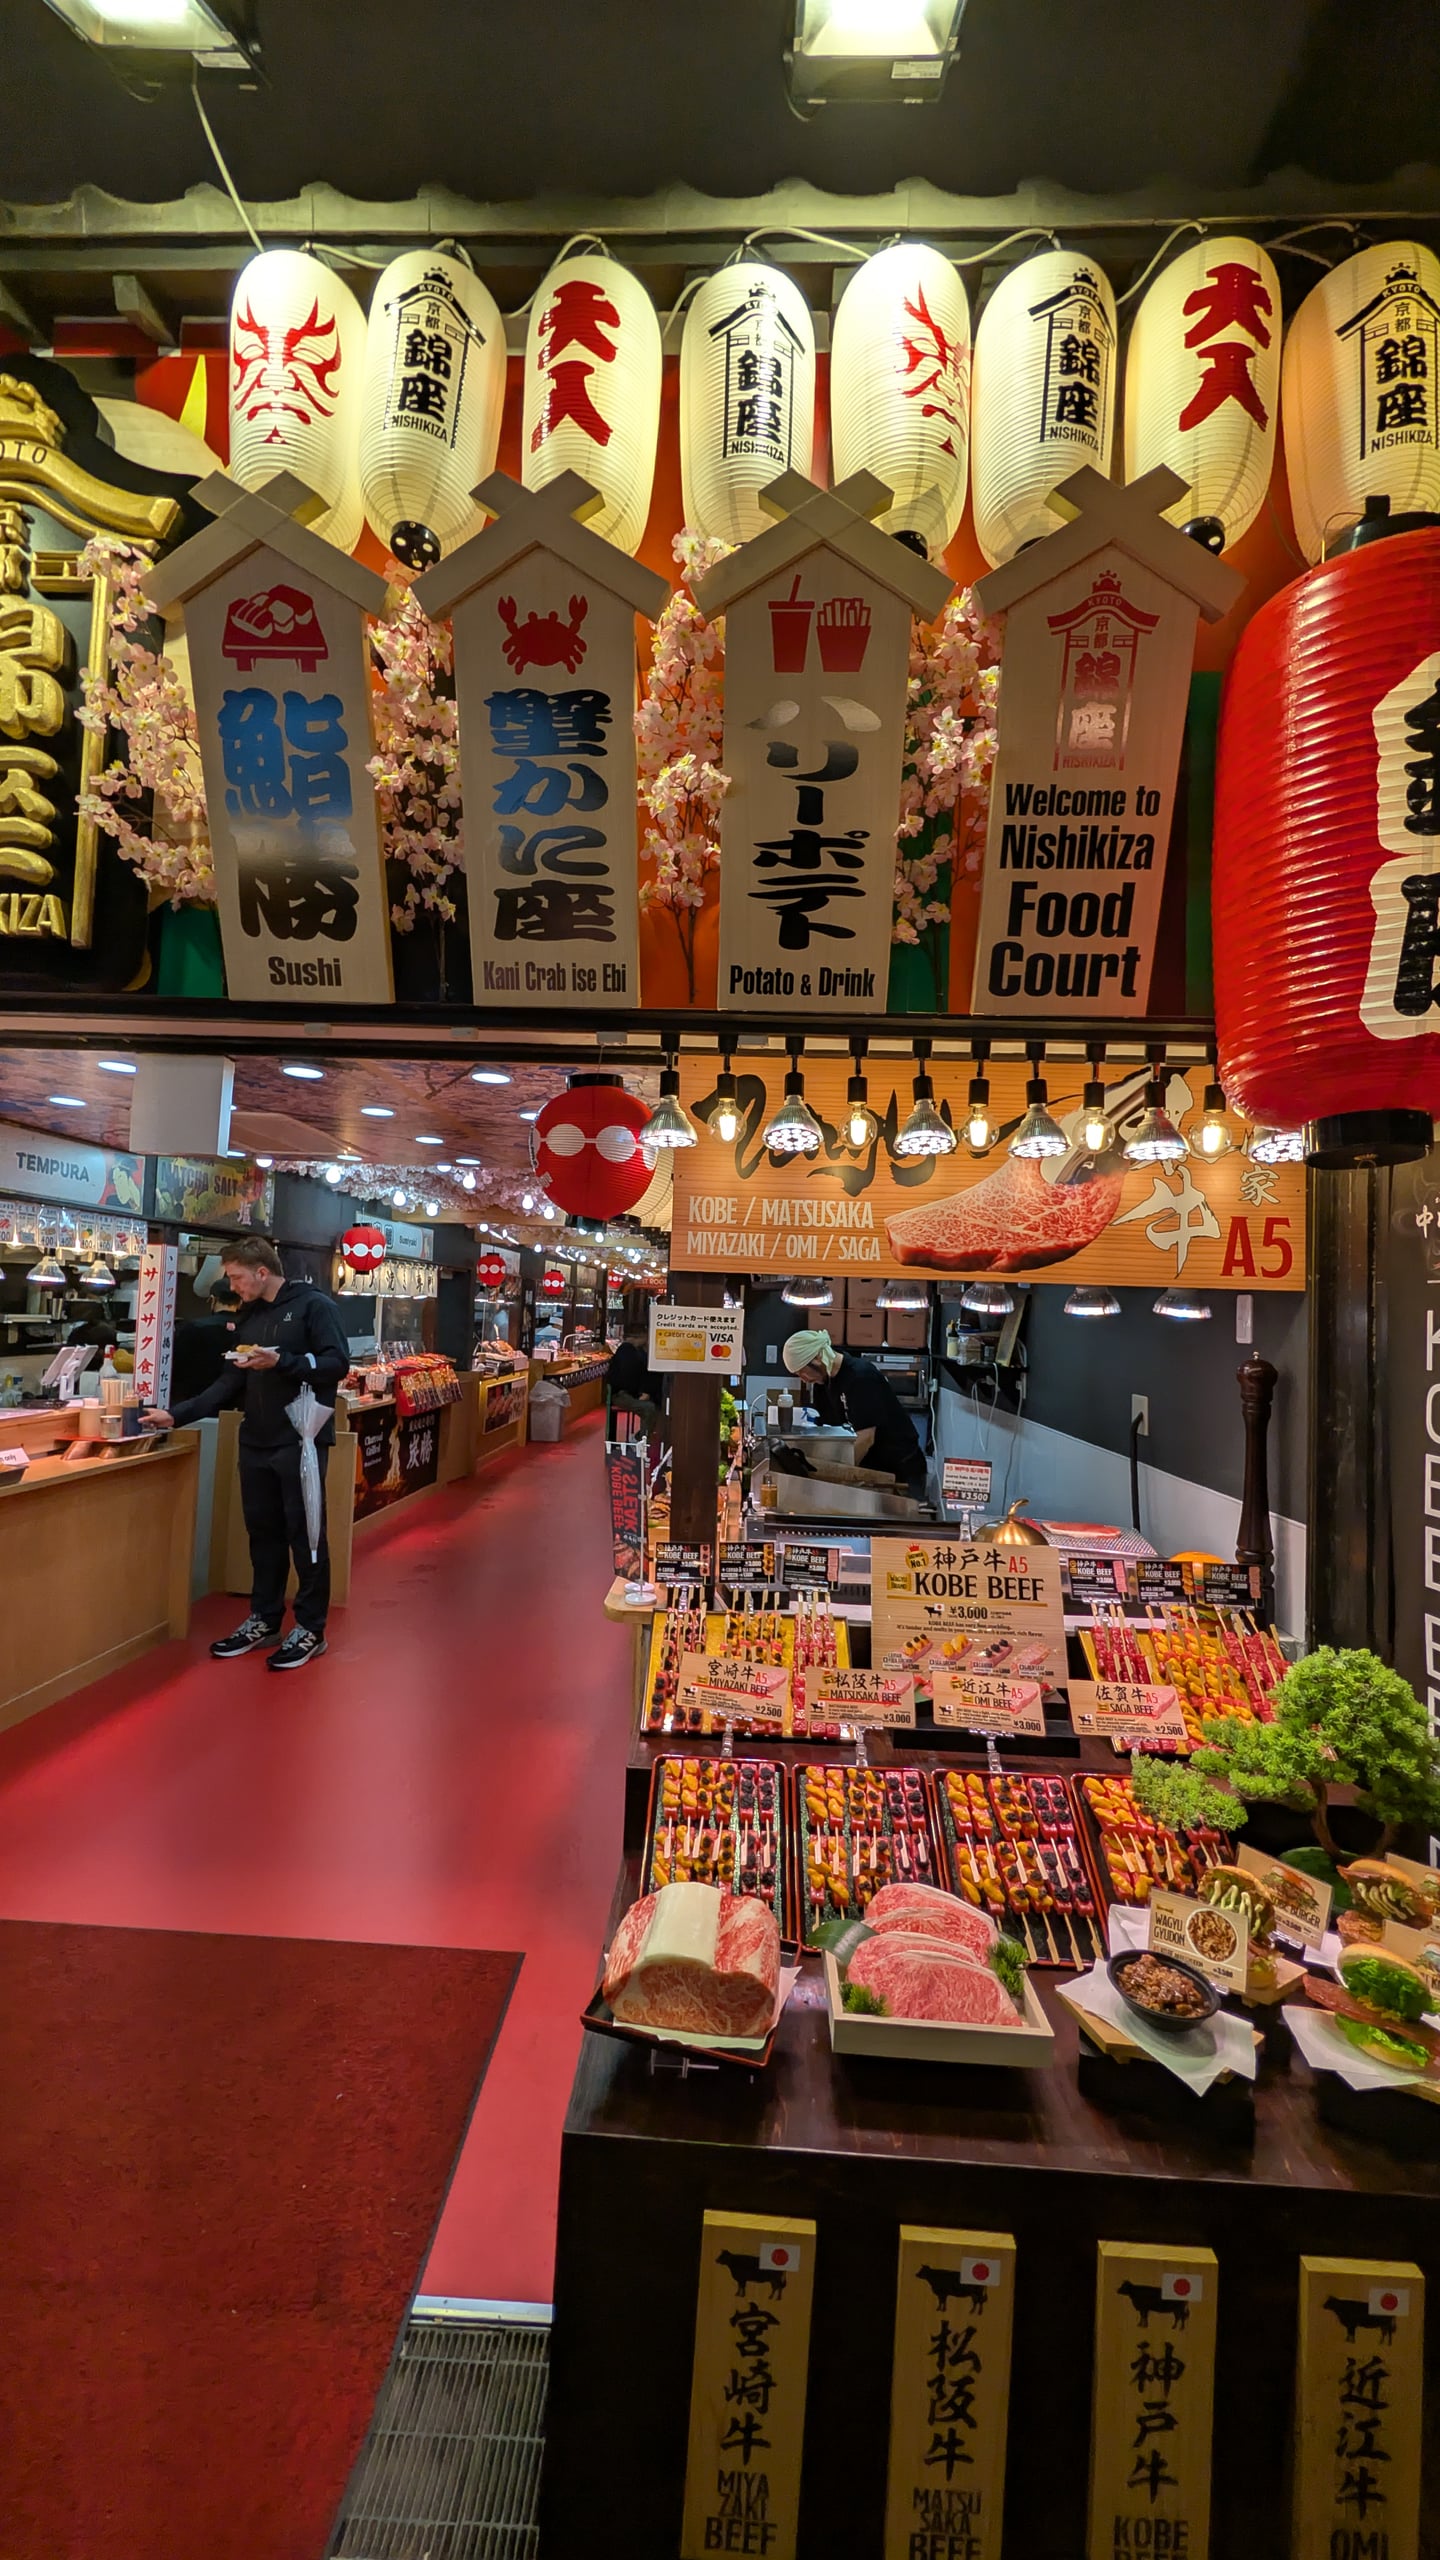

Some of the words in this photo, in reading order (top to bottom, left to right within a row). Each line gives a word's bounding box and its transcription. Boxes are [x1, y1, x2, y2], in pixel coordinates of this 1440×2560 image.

[419, 283, 454, 302] KYOTO
[1382, 283, 1420, 298] KYOTO
[425, 302, 443, 330] 京都
[1078, 304, 1091, 334] 京都
[1394, 302, 1411, 332] 京都
[398, 329, 452, 423] 錦座
[1055, 334, 1100, 432] 錦座
[1375, 334, 1428, 433] 錦座
[391, 415, 448, 443] NISHIKIZA
[1371, 430, 1434, 453] NISHIKIZA
[1087, 596, 1122, 606] KYOTO
[1093, 616, 1111, 649] 京都
[1067, 651, 1121, 750] 錦座
[1004, 783, 1127, 818] Welcome
[1134, 785, 1161, 817] to
[489, 688, 618, 943] 蟹かに座
[998, 824, 1156, 871] Nishikiza
[1007, 881, 1132, 938] Food
[268, 956, 342, 988] Sushi
[484, 961, 520, 991] Kani
[525, 961, 566, 992] Crab
[572, 962, 597, 992] ise
[602, 963, 627, 992] Ebi
[730, 964, 794, 998] Potato
[800, 975, 812, 997] &
[818, 966, 875, 998] Drink
[988, 941, 1141, 998] Court
[16, 1152, 89, 1183] TEMPURA
[213, 1177, 239, 1197] SALT
[688, 1195, 737, 1225] KOBE
[744, 1196, 756, 1226] /
[762, 1199, 875, 1229] MATSUSAKA
[687, 1231, 765, 1257] MIYAZAKI
[769, 1232, 782, 1259] /
[786, 1234, 818, 1260] OMI
[822, 1234, 834, 1261] /
[838, 1236, 881, 1261] SAGA
[1220, 1216, 1293, 1279] A5
[656, 1313, 737, 1324] クレジットカード使えます
[160, 1270, 175, 1409] アツアツ揚げたて
[663, 1331, 686, 1339] CREDIT
[709, 1333, 734, 1343] VISA
[683, 1552, 699, 1560] BEEF
[727, 1551, 745, 1559] KOBE
[746, 1551, 762, 1559] BEEF
[792, 1554, 809, 1562] KOBE
[910, 1559, 926, 1568] No.1
[932, 1546, 1007, 1573] 神戸牛
[1008, 1556, 1029, 1574] A5
[914, 1572, 978, 1598] KOBE
[987, 1575, 1044, 1601] BEEF
[1145, 1570, 1162, 1578] KOBE
[708, 1659, 756, 1681] 宮崎牛
[755, 1671, 768, 1684] A5
[834, 1671, 885, 1690] 松阪牛
[884, 1679, 896, 1691] A5
[709, 1677, 748, 1692] MIYAZAKI
[750, 1683, 770, 1695] BEEF
[830, 1689, 879, 1702] MATSUSAKA
[881, 1692, 902, 1703] BEEF
[962, 1678, 1011, 1697] 近江牛
[1011, 1687, 1024, 1699] A5
[1096, 1684, 1146, 1703] 佐賀牛
[1145, 1692, 1159, 1704] A5
[974, 1696, 991, 1706] OMI
[993, 1698, 1013, 1709] BEEF
[1109, 1703, 1132, 1713] SAGA
[1134, 1705, 1154, 1715] BEEF
[1155, 1912, 1183, 1931] WAGYU
[1291, 1905, 1321, 1928] BURGER
[1153, 1926, 1185, 1946] GYUDON
[720, 2302, 780, 2466] 宮崎牛
[924, 2320, 982, 2482] 松阪牛
[1127, 2341, 1185, 2504] 神戸牛
[1335, 2356, 1392, 2521] 近江牛
[717, 2469, 769, 2496] MIYA
[718, 2493, 769, 2521] ZAKI
[912, 2488, 982, 2515] MATSU
[703, 2517, 778, 2556] BEEF
[919, 2512, 971, 2535] SAKA
[1113, 2514, 1189, 2550] KOBE
[909, 2533, 984, 2560] BEEF
[1331, 2529, 1390, 2560] OMI
